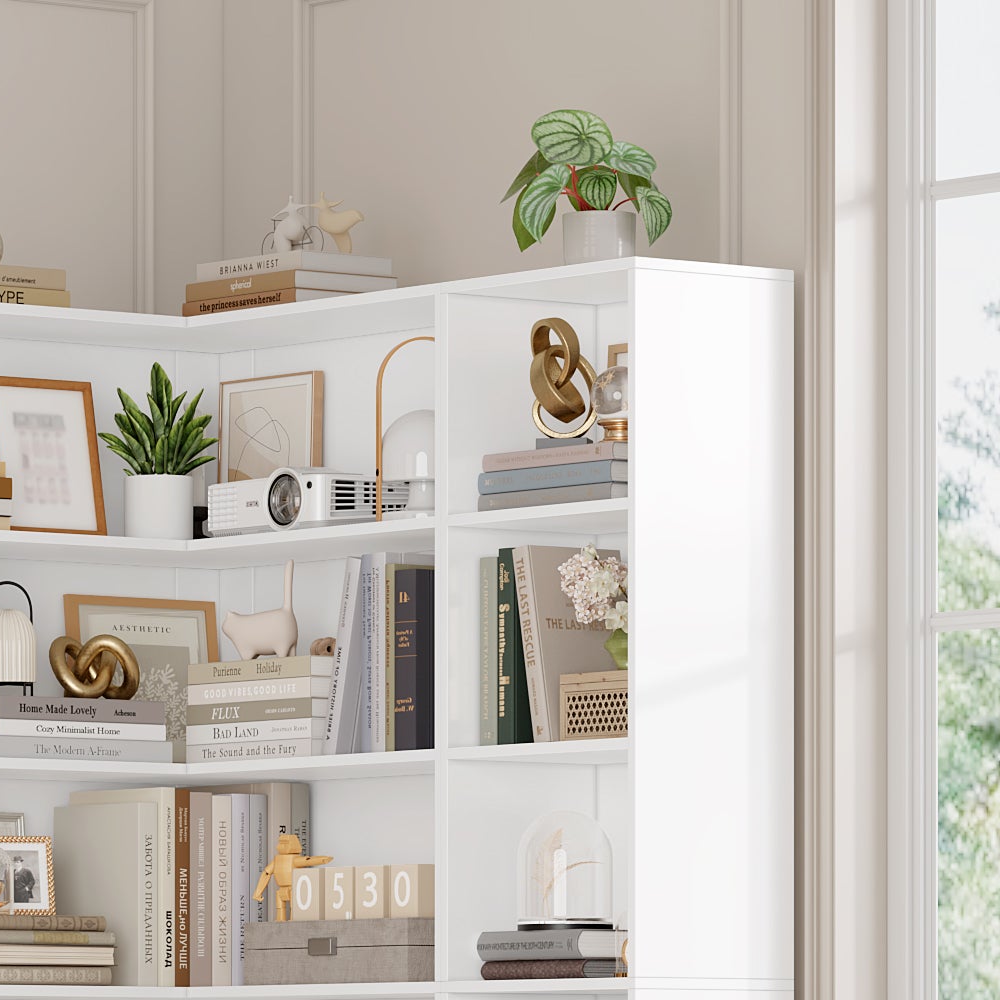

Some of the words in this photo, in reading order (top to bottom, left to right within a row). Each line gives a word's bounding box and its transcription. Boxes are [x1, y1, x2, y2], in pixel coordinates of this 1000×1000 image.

[219, 264, 253, 275] BRIANNA
[257, 259, 279, 269] WIEST
[515, 558, 525, 583] THE
[519, 586, 530, 616] LAST
[112, 624, 172, 634] AESTHETIC
[546, 618, 564, 629] THE
[523, 620, 536, 668] RESCUE
[213, 666, 241, 677] Purienne
[256, 662, 282, 675] Holiday
[19, 704, 43, 714] Home
[45, 705, 68, 715] Made
[70, 706, 97, 719] Lovely
[114, 709, 136, 717] Acheson
[211, 707, 240, 720] FLUX
[36, 725, 55, 734] Cozy
[57, 726, 95, 735] Minimalist
[97, 727, 120, 735] Home
[213, 727, 232, 740] BAD
[235, 726, 259, 738] LAND
[34, 744, 51, 754] The
[53, 745, 84, 756] Modern
[88, 746, 122, 757] A-Frame
[202, 749, 216, 759] The
[219, 746, 243, 758] Sound
[246, 746, 261, 756] and
[263, 745, 276, 755] the
[279, 744, 296, 756] Fury
[218, 821, 228, 867] НОВЫЙ
[144, 834, 153, 876] ЗАБОТА
[144, 881, 153, 890] О
[218, 872, 227, 912] ОБРАЗ
[144, 892, 153, 964] ПРЕДАННЫХ
[164, 911, 173, 968] ШОКОЛАД
[218, 915, 227, 964] ЖИЗНИ
